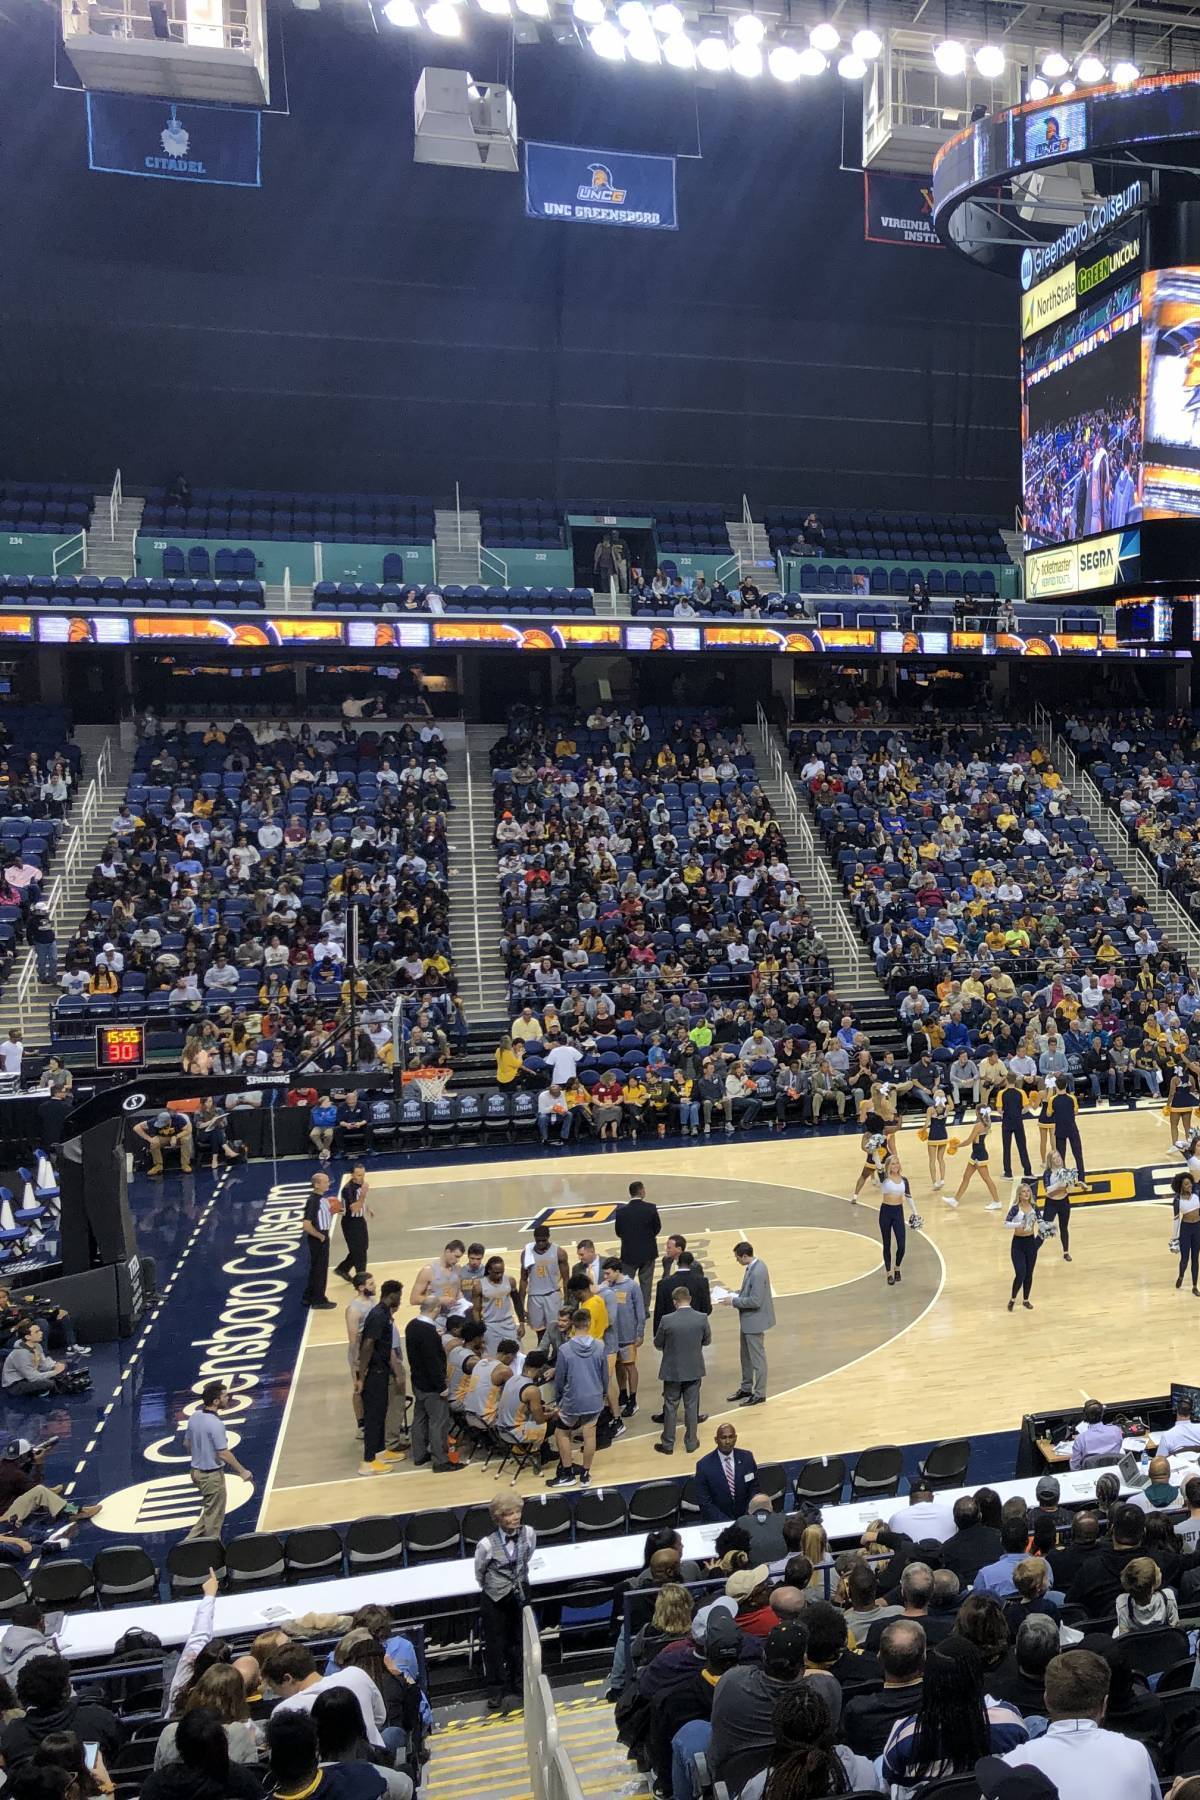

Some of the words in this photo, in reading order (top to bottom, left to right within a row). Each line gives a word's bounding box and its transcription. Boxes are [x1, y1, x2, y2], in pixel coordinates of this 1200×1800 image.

[145, 157, 207, 173] CITADEL
[579, 187, 624, 203] UNCG
[544, 203, 571, 216] UNC
[575, 206, 660, 225] GREENSBORO
[881, 216, 930, 231] VIRGINIA
[1034, 220, 1088, 274] Greensboro
[1090, 180, 1141, 233] Coliseum
[1077, 255, 1110, 295] GREEN
[1109, 238, 1140, 273] LINCOLN
[1037, 281, 1075, 315] NorthState
[9, 537, 23, 545] 234
[1080, 548, 1114, 572] SEGRA
[107, 1031, 139, 1043] 15:55
[110, 1045, 132, 1060] 30
[247, 1075, 291, 1085] SPALDING
[222, 1182, 312, 1274] Coliseum
